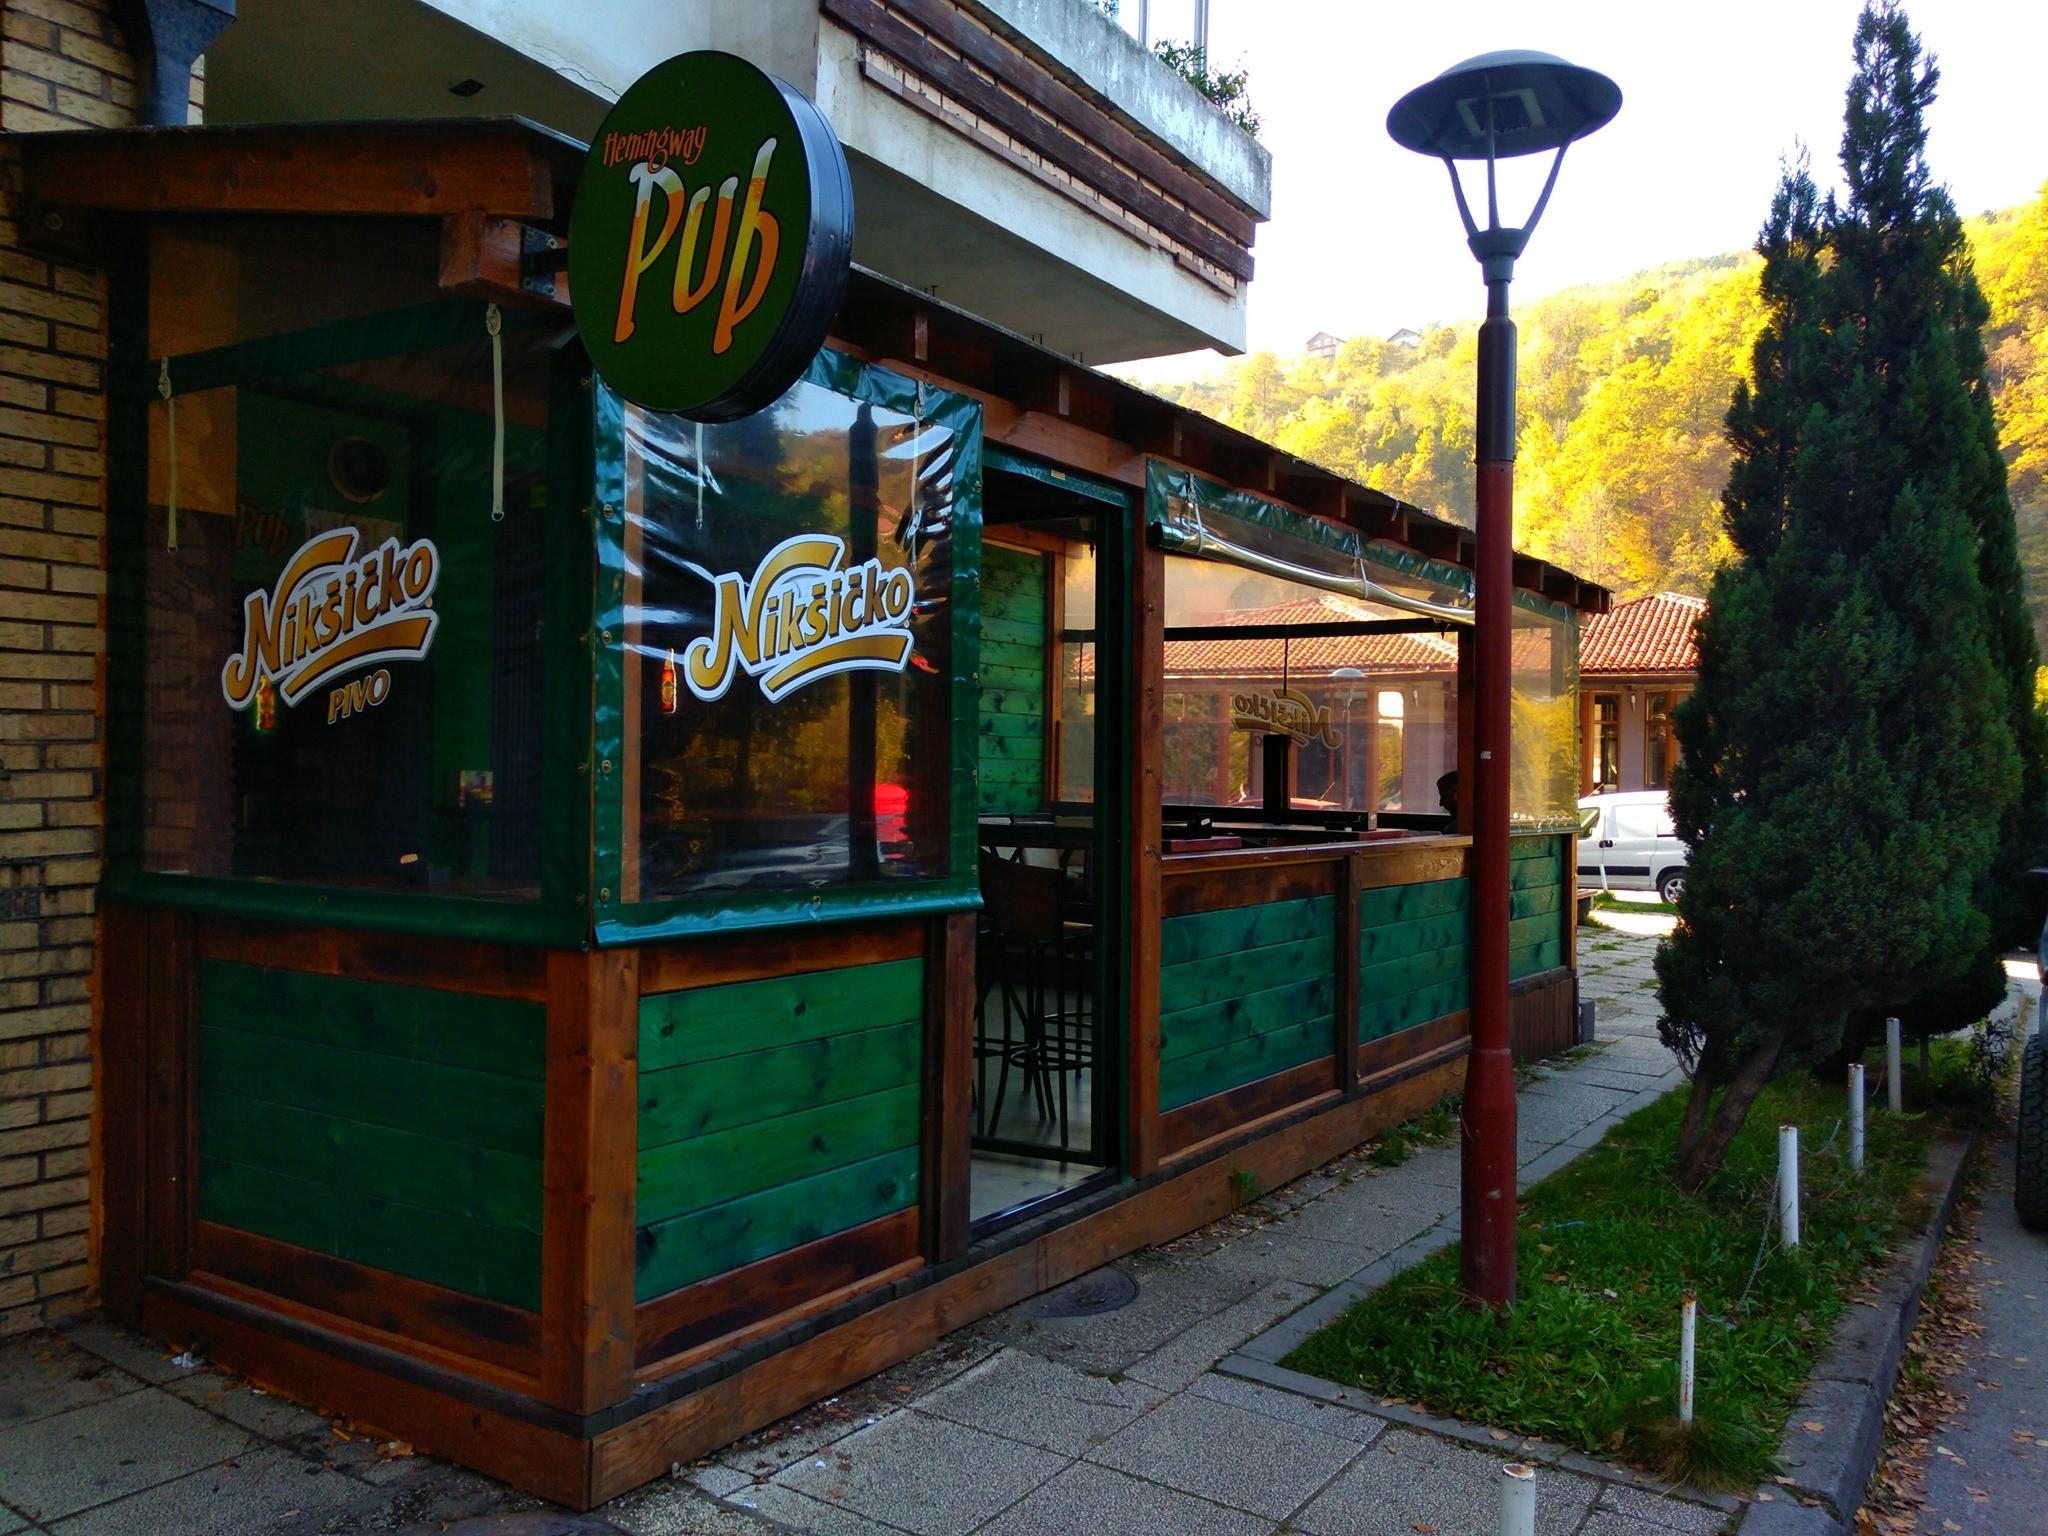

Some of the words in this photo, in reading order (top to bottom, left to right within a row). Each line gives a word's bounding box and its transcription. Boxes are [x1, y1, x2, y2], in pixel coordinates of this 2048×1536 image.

[602, 125, 708, 174] Hemingway
[613, 136, 779, 354] Pub
[327, 669, 391, 725] PIVO
